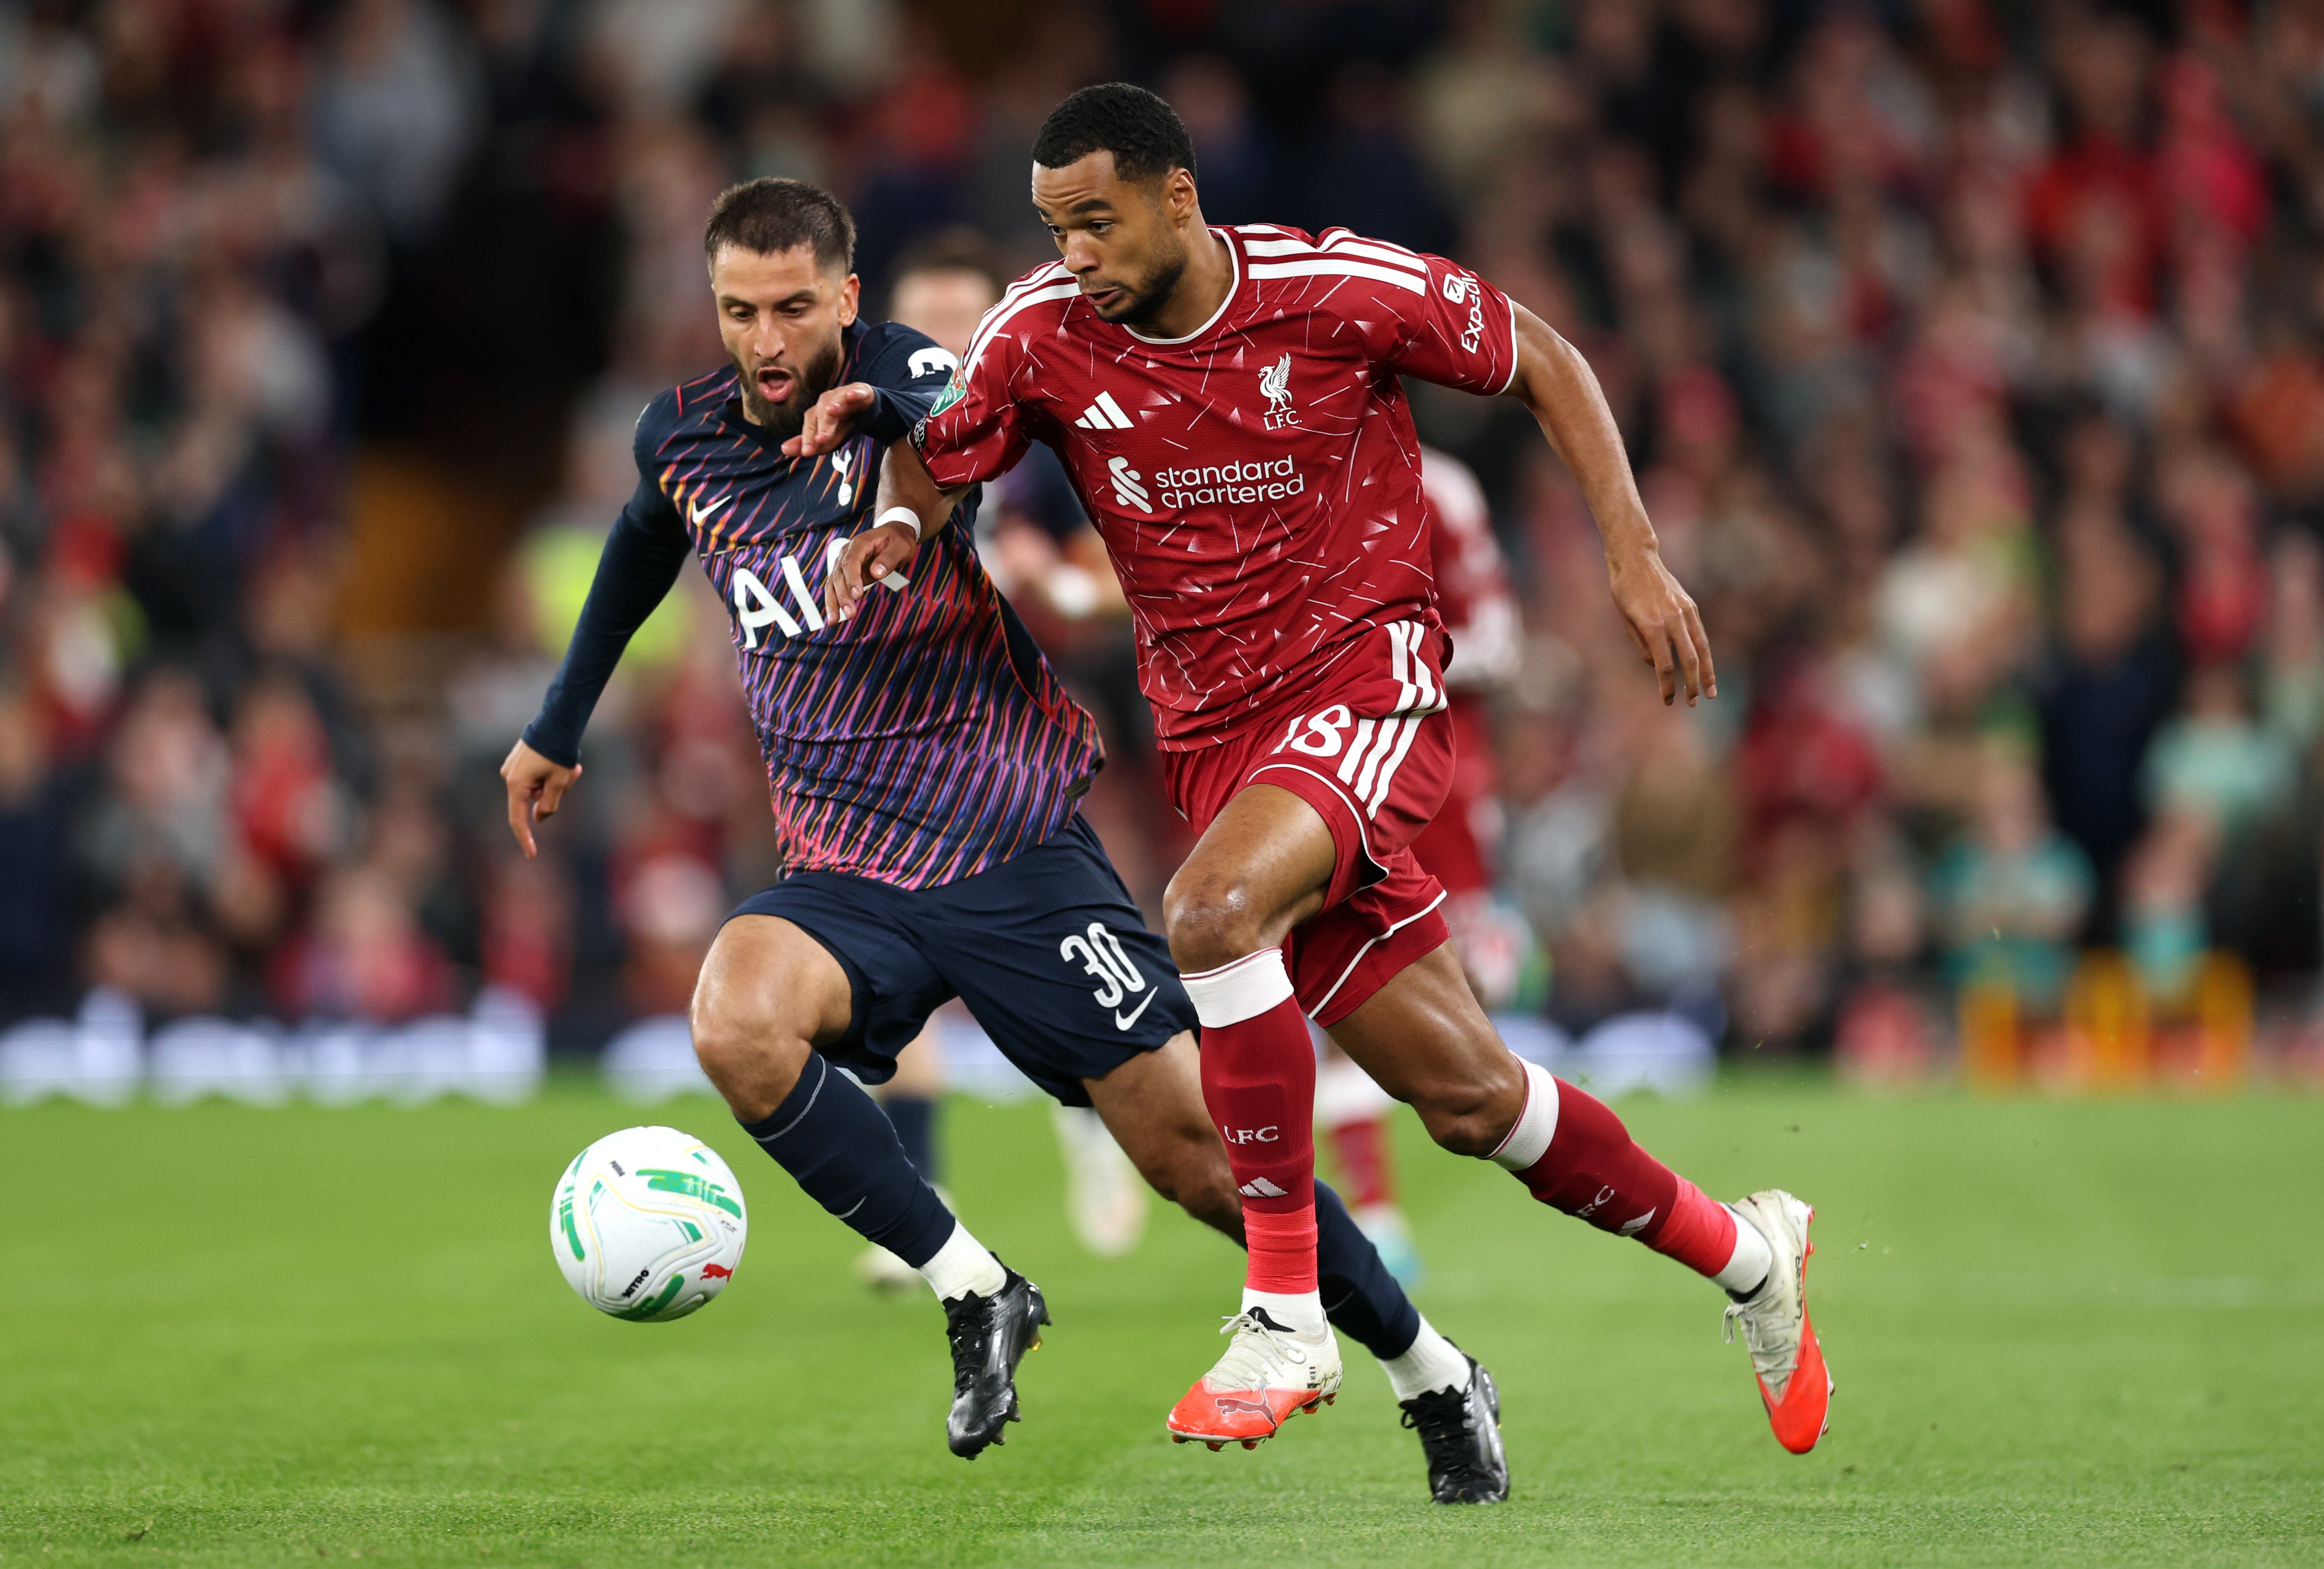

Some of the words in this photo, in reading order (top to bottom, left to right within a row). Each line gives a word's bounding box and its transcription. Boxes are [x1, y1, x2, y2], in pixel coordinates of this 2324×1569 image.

[1155, 454, 1294, 488] standard
[1161, 474, 1304, 509] chartered
[1270, 704, 1351, 757] 18
[1060, 922, 1146, 1008] 30
[1224, 1125, 1279, 1145] LFC
[1576, 1185, 1615, 1217] FC
